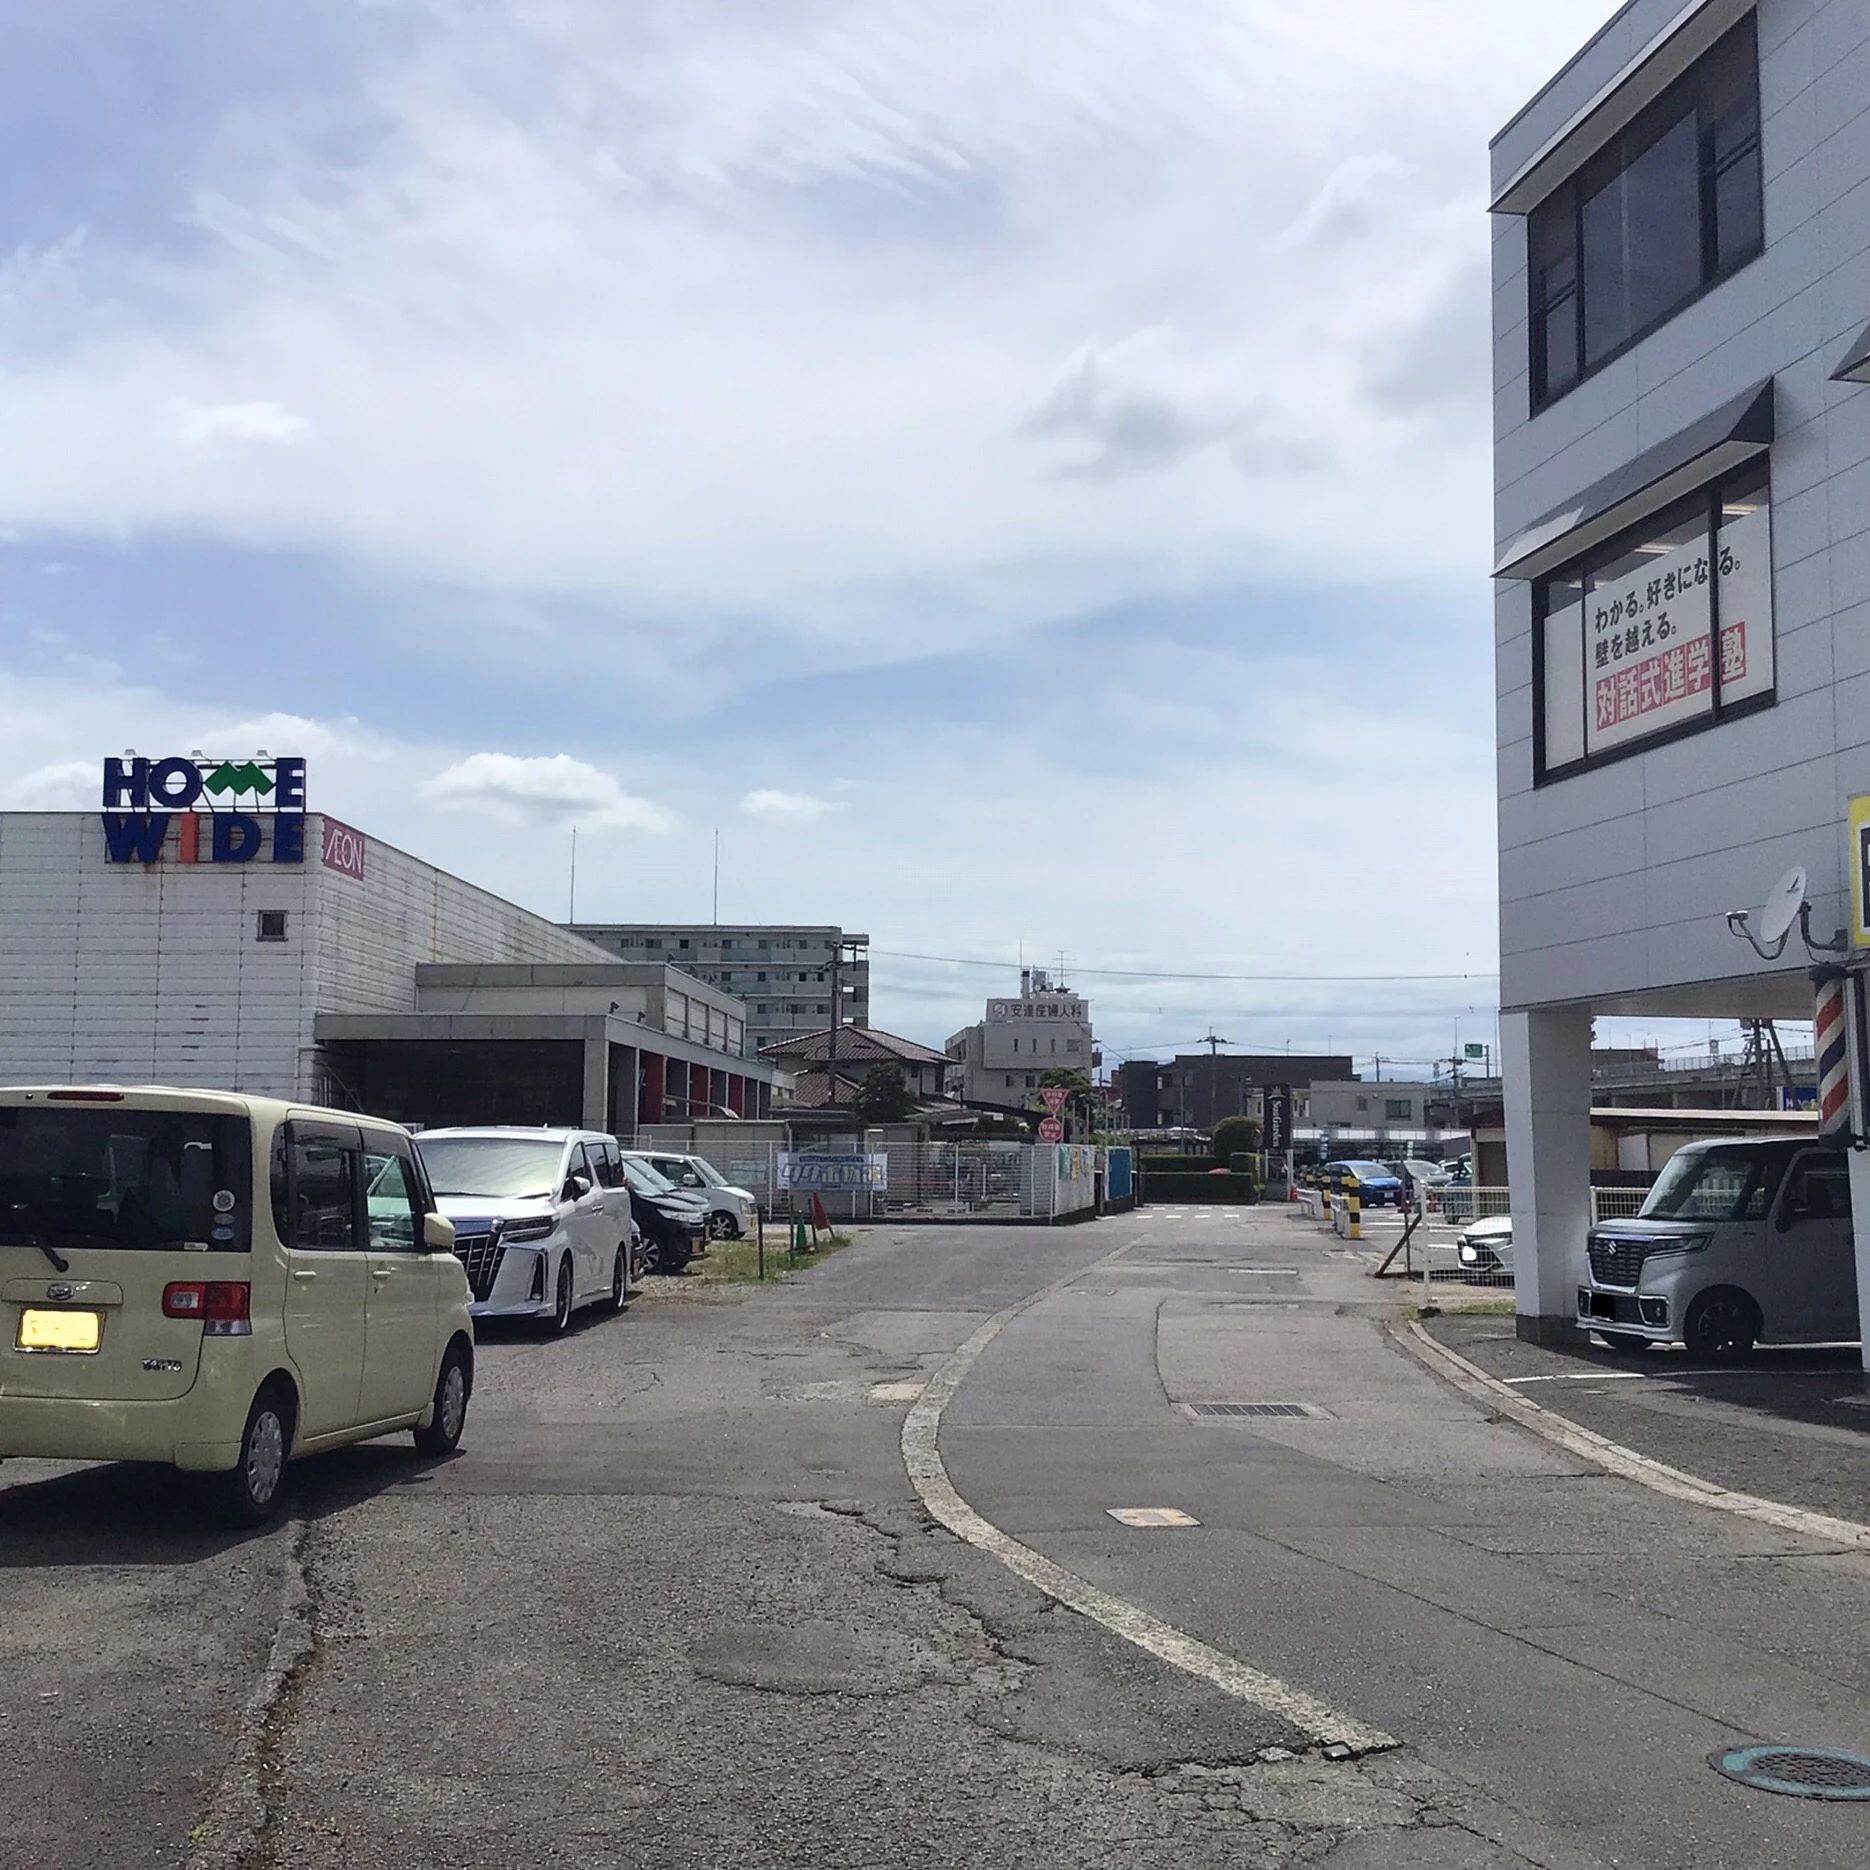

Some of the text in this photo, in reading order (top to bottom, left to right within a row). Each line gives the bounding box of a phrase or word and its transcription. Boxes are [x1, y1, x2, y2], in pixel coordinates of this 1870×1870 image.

[1595, 546, 1741, 634] わかる。好きになる。
[1595, 612, 1677, 669] 壁を越える。
[1598, 625, 1745, 729] 対話式進学塾
[103, 757, 306, 808] HOME
[102, 812, 304, 863] WIDE
[1011, 1003, 1082, 1018] 安達産婦人科
